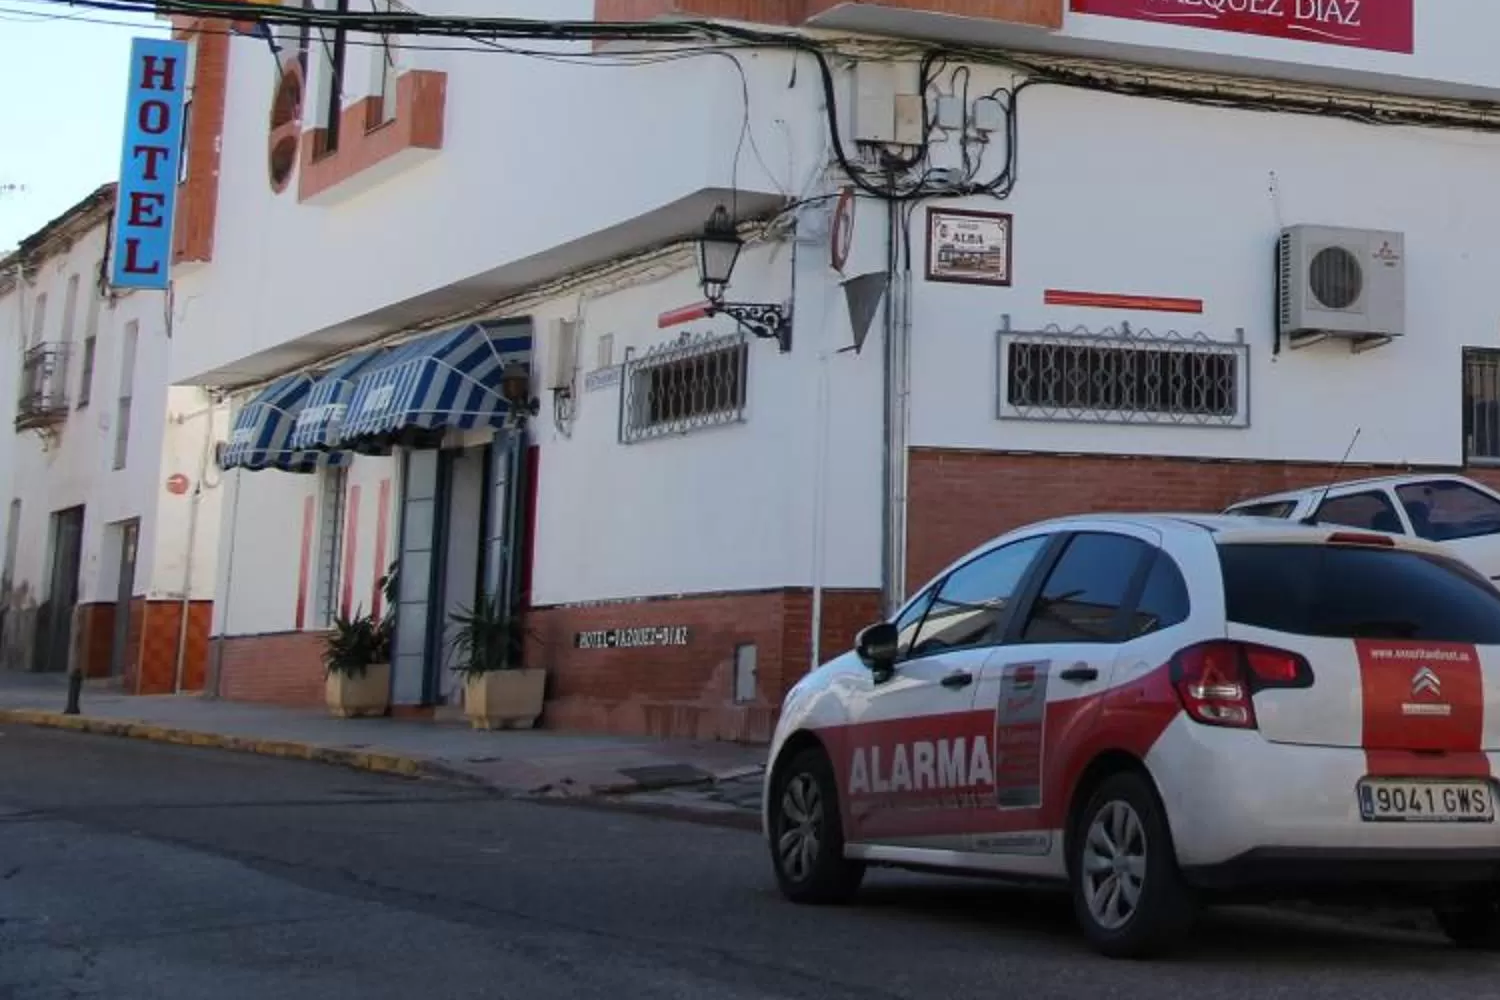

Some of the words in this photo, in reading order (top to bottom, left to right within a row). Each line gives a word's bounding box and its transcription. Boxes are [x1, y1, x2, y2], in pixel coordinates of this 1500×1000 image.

[121, 55, 177, 275] HOTEL
[848, 735, 995, 794] ALARMA
[1377, 786, 1435, 813] 9041
[1442, 786, 1487, 814] GWS
